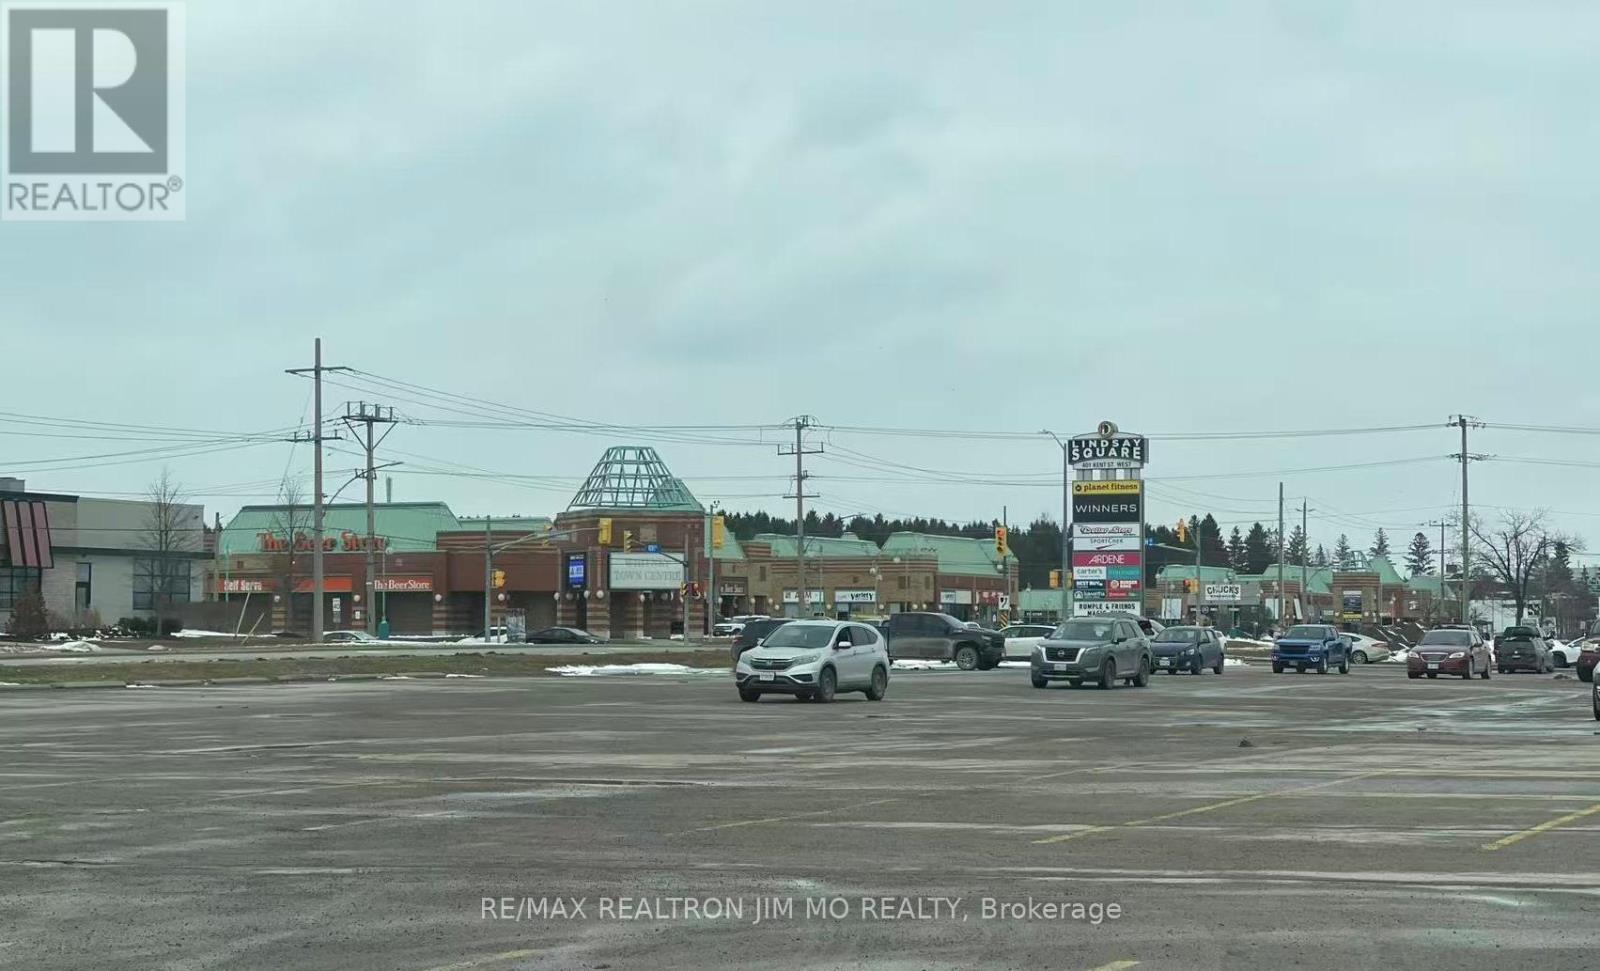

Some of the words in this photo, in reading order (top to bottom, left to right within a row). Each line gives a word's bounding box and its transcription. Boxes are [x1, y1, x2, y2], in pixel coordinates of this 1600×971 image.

[1072, 438, 1141, 448] LINDSAY
[1072, 447, 1141, 461] SQUARE
[1084, 483, 1109, 492] planet
[1111, 483, 1137, 491] fitness
[1075, 504, 1137, 513] WINNERS
[1088, 554, 1125, 564] ARDENE
[1077, 567, 1103, 575] carter's
[374, 579, 388, 590] The
[388, 579, 407, 590] Beer
[408, 579, 430, 590] Store
